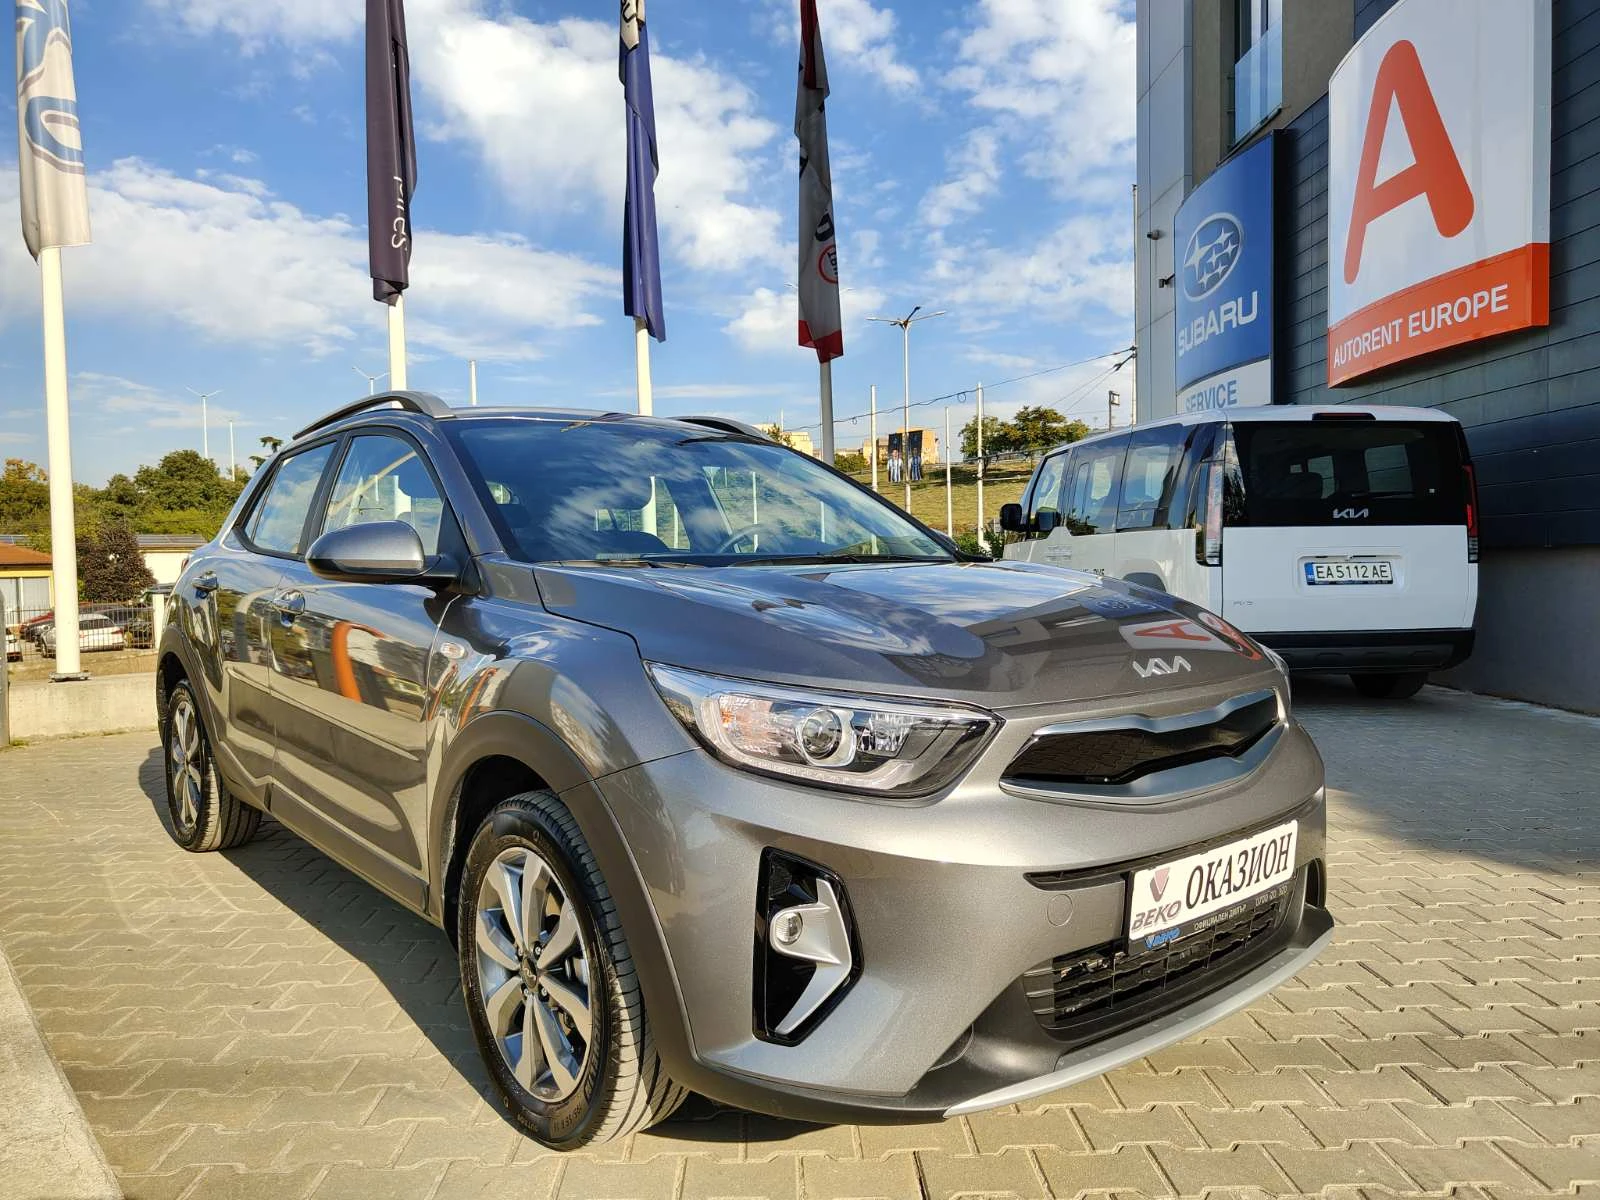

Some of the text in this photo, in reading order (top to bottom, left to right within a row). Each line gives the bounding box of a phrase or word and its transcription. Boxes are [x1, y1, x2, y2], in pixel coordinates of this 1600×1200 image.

[1344, 39, 1475, 284] A
[1178, 290, 1258, 358] SUBARU
[1333, 283, 1509, 369] AUTORENT EUROPE
[1185, 379, 1238, 412] SERVICE
[1185, 832, 1293, 910] ОКАЗИОН
